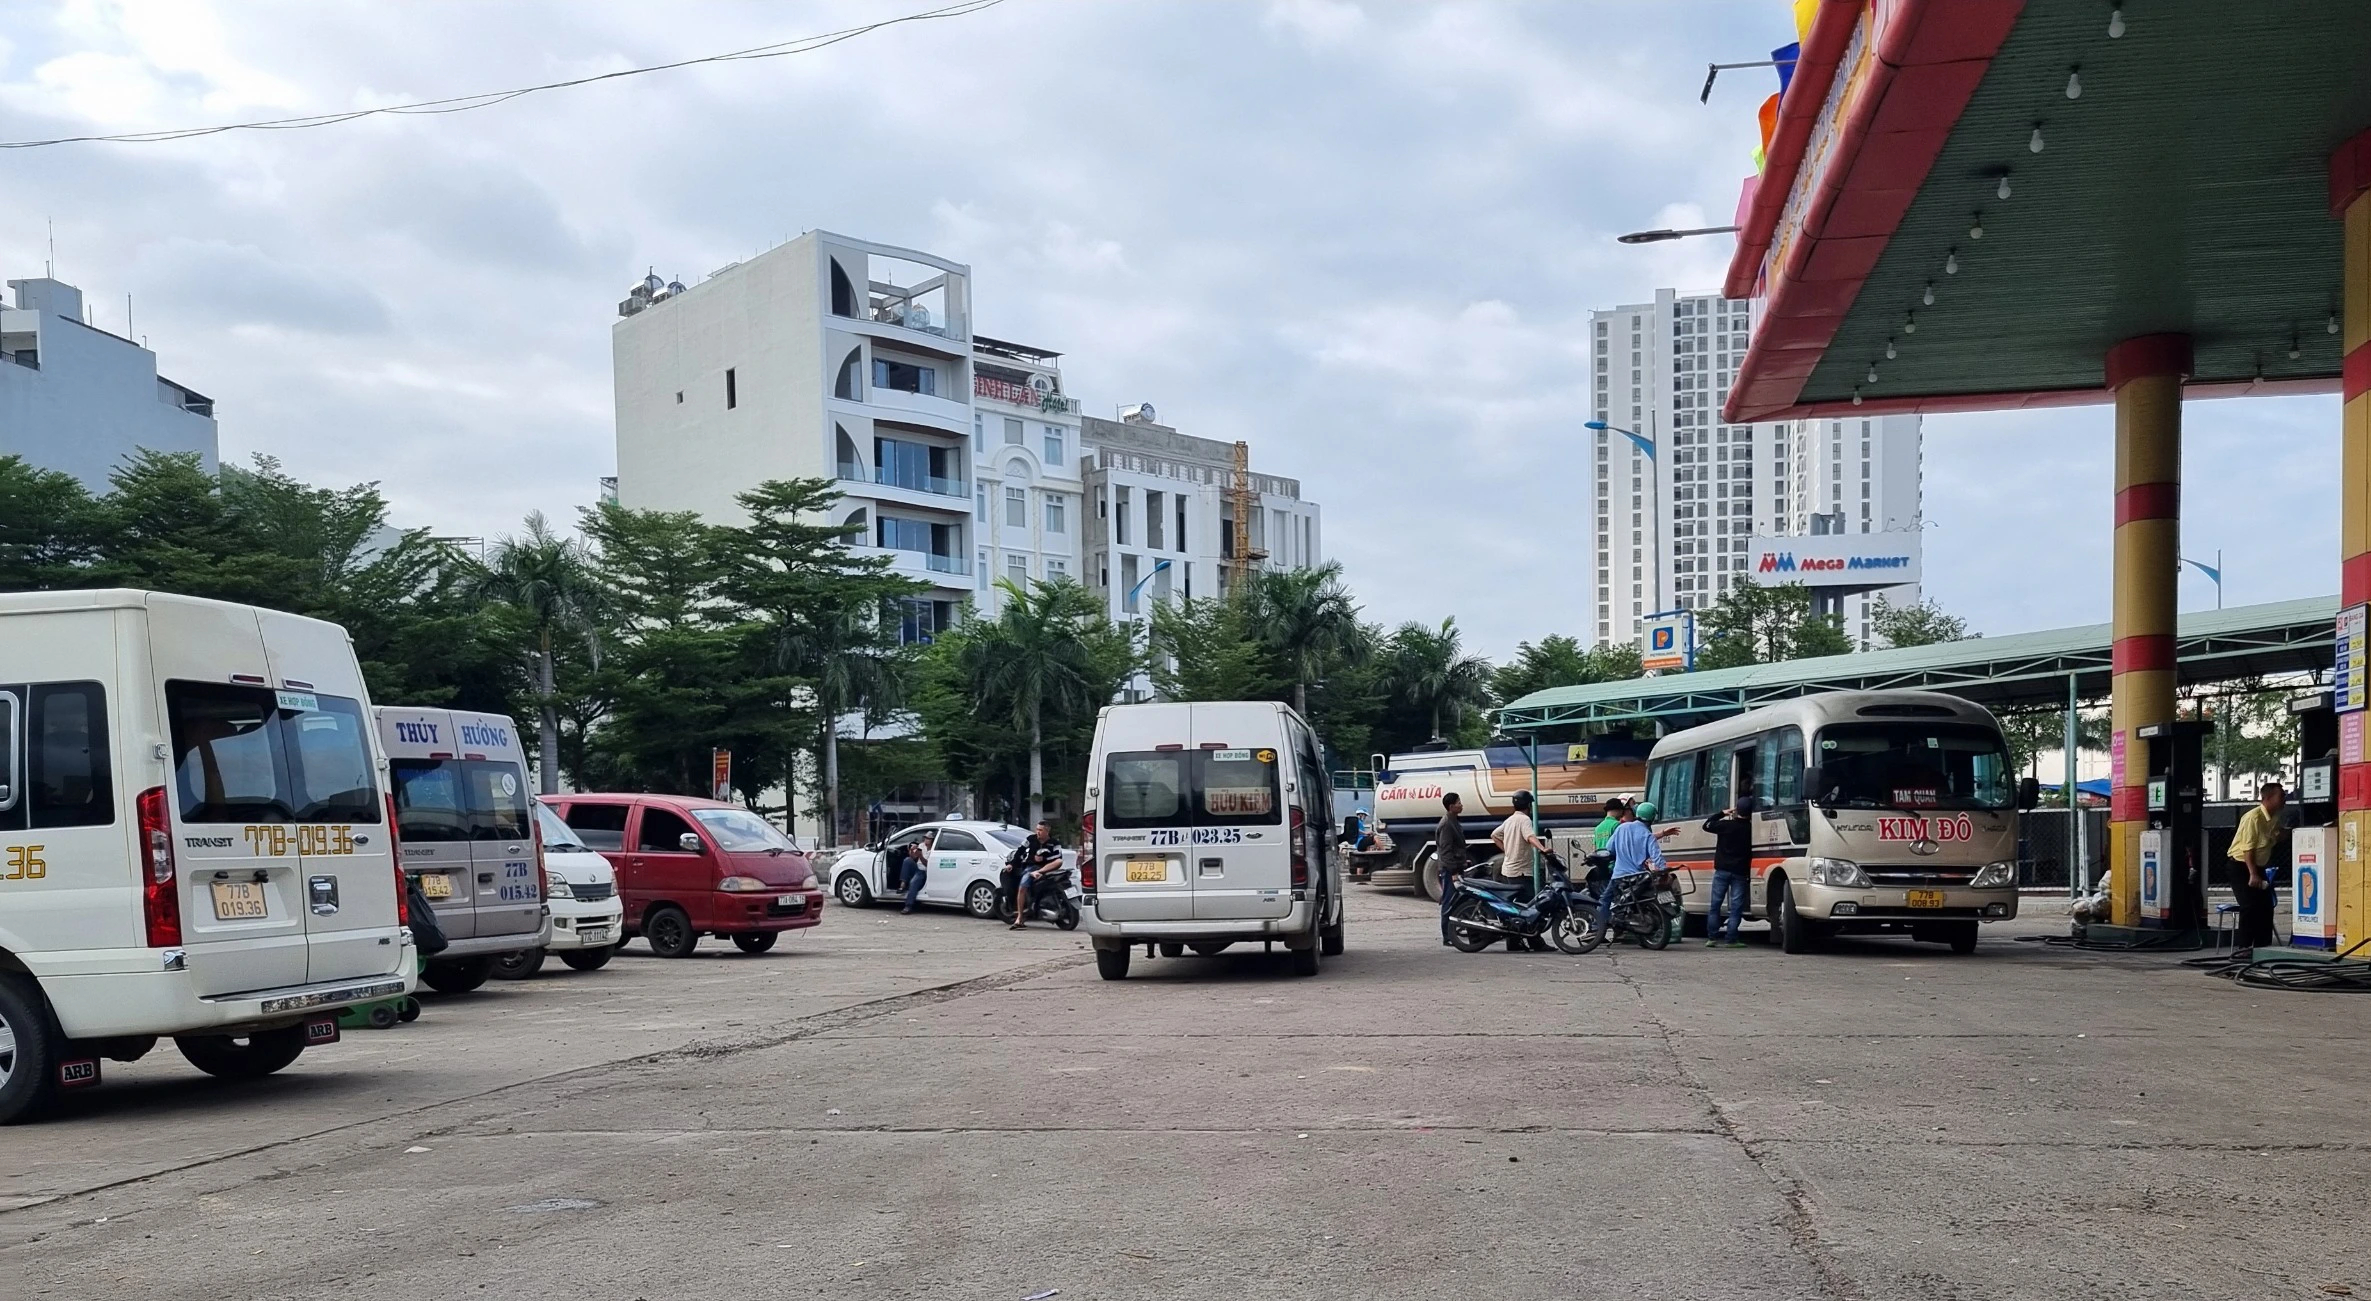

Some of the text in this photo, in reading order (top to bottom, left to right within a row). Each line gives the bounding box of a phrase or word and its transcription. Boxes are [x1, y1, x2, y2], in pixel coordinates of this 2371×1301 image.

[396, 717, 507, 747] THÚY HƯỜNG
[1568, 795, 1579, 803] 77C
[1893, 790, 1936, 804] TAM QUAN
[1878, 811, 1973, 842] KIM ĐÔ
[185, 837, 234, 848] TRANSIT
[1151, 828, 1241, 846] 77B 023.25
[505, 862, 528, 877] 77B
[1138, 862, 1155, 871] 77B
[427, 875, 441, 885] 77B
[1131, 872, 1162, 881] 023.25
[227, 885, 250, 899] 77B
[500, 884, 538, 900] 015.42
[1918, 891, 1934, 899] 77B
[222, 901, 262, 917] 019.36
[310, 1023, 333, 1037] ARB
[63, 1063, 93, 1080] ARB
